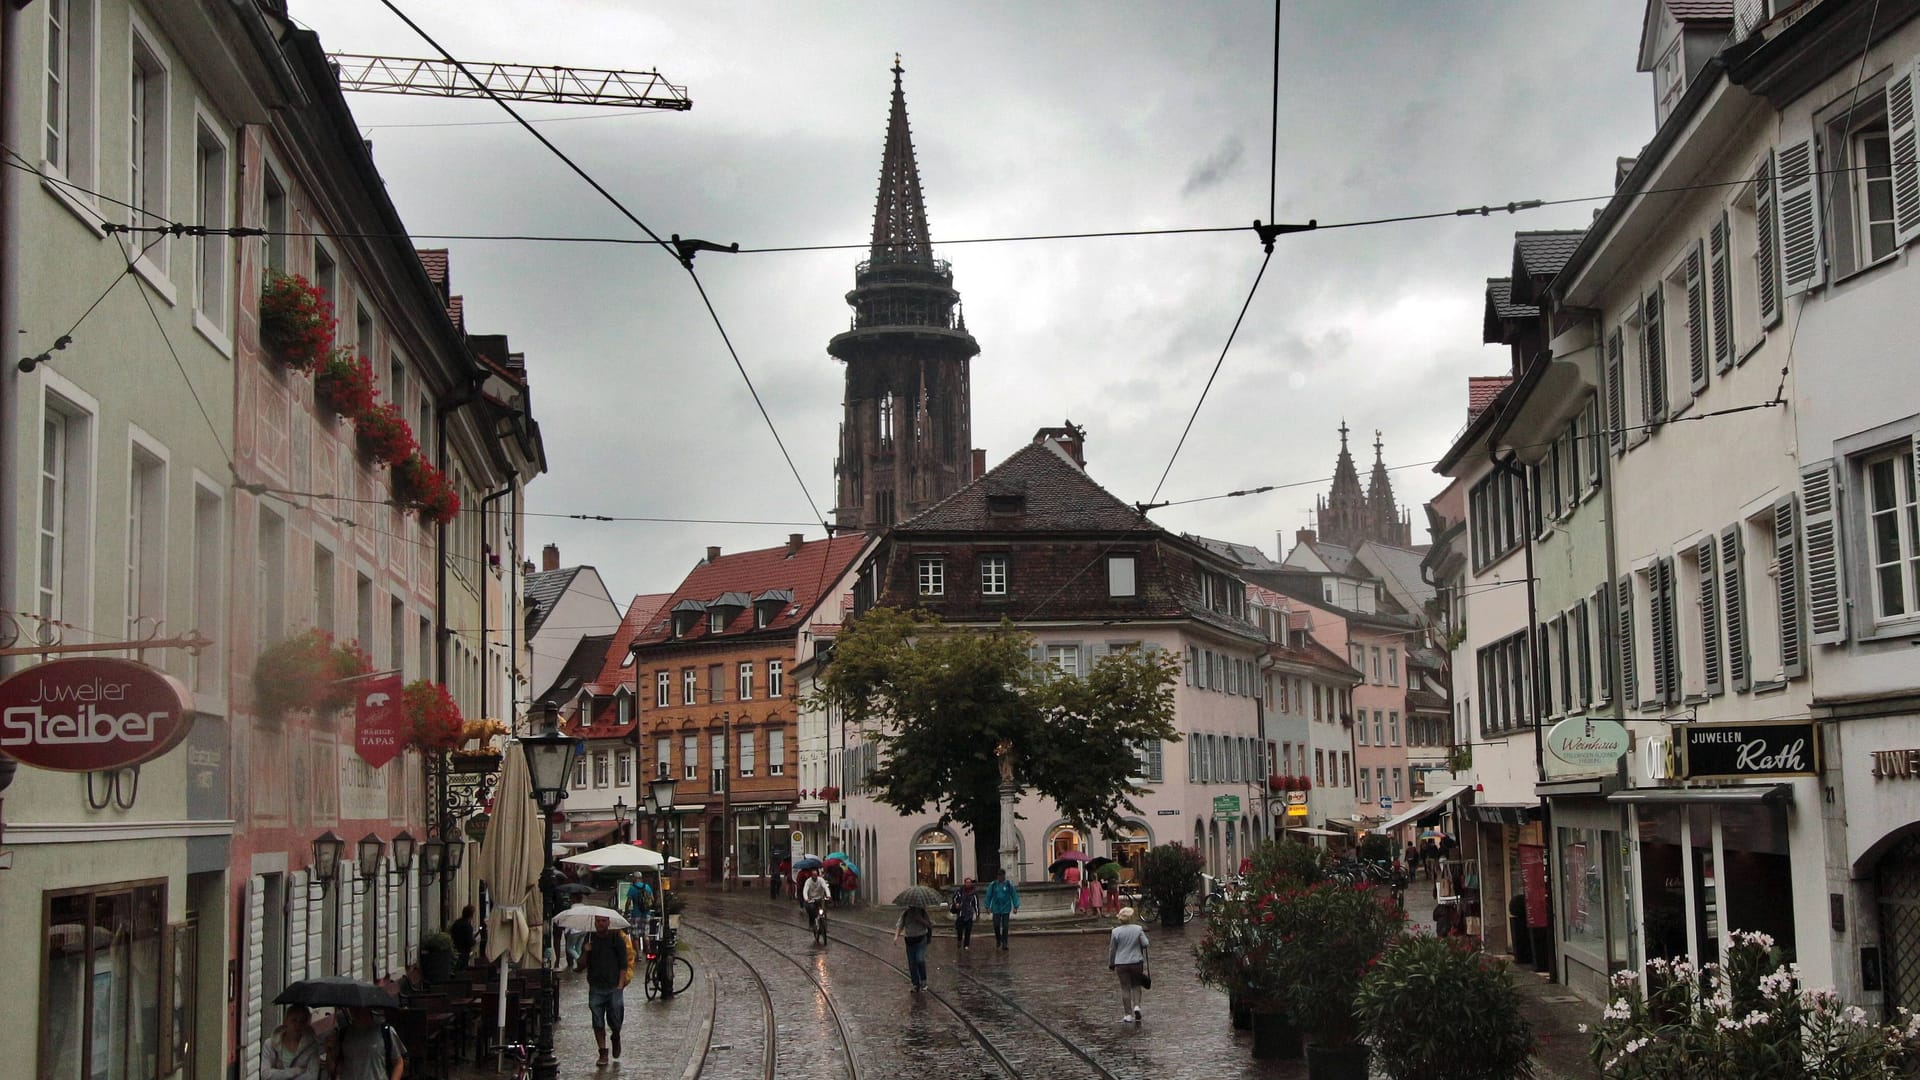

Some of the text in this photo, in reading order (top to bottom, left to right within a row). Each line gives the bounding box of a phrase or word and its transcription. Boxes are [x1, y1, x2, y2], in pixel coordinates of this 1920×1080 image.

[31, 677, 132, 703] Juwelier
[1, 704, 168, 745] Steiber
[360, 737, 395, 745] TAPAS
[1562, 737, 1618, 751] Weinhaus
[1691, 731, 1742, 744] JUWELEN
[1736, 738, 1805, 771] Rath
[1825, 786, 1836, 806] 21
